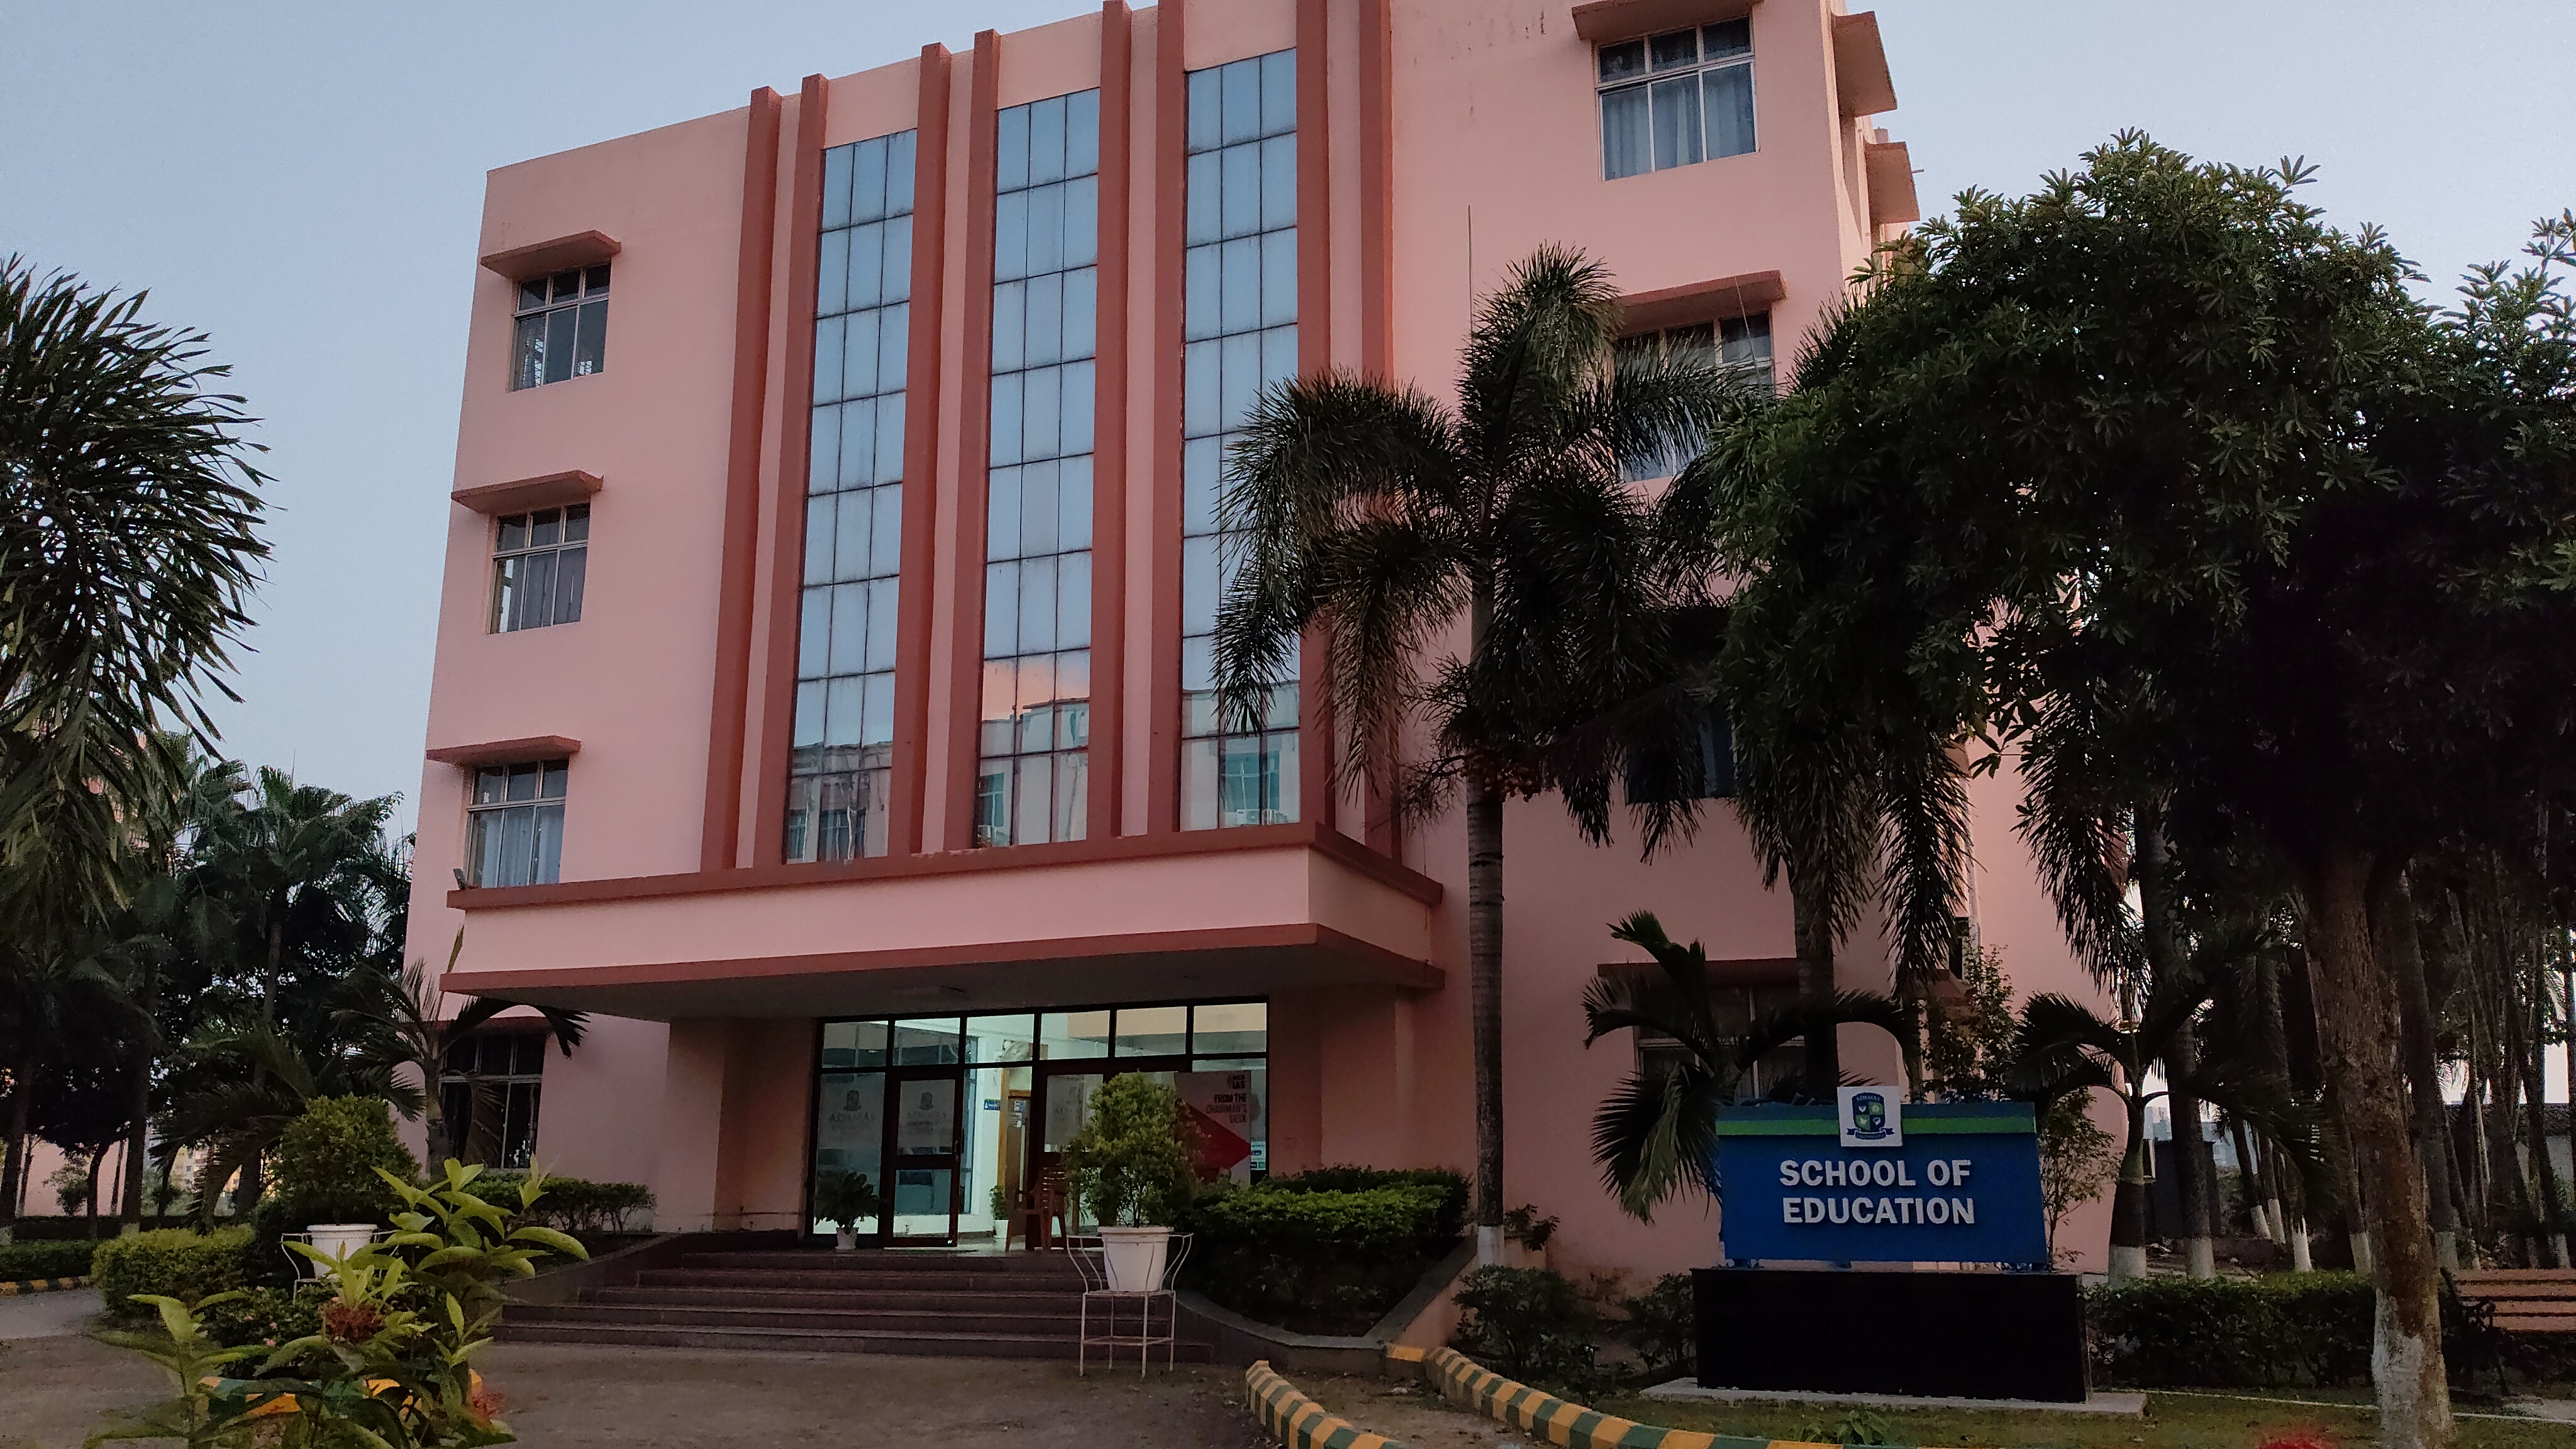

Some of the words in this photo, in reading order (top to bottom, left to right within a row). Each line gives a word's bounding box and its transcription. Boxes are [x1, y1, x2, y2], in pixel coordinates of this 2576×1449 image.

[1233, 1080, 1245, 1089] IAS
[1214, 1094, 1233, 1103] FROM
[1234, 1093, 1246, 1102] THE
[1780, 1159, 1916, 1186] SCHOOL
[1927, 1159, 1972, 1186] OF
[1782, 1197, 1975, 1224] EDUCATION
